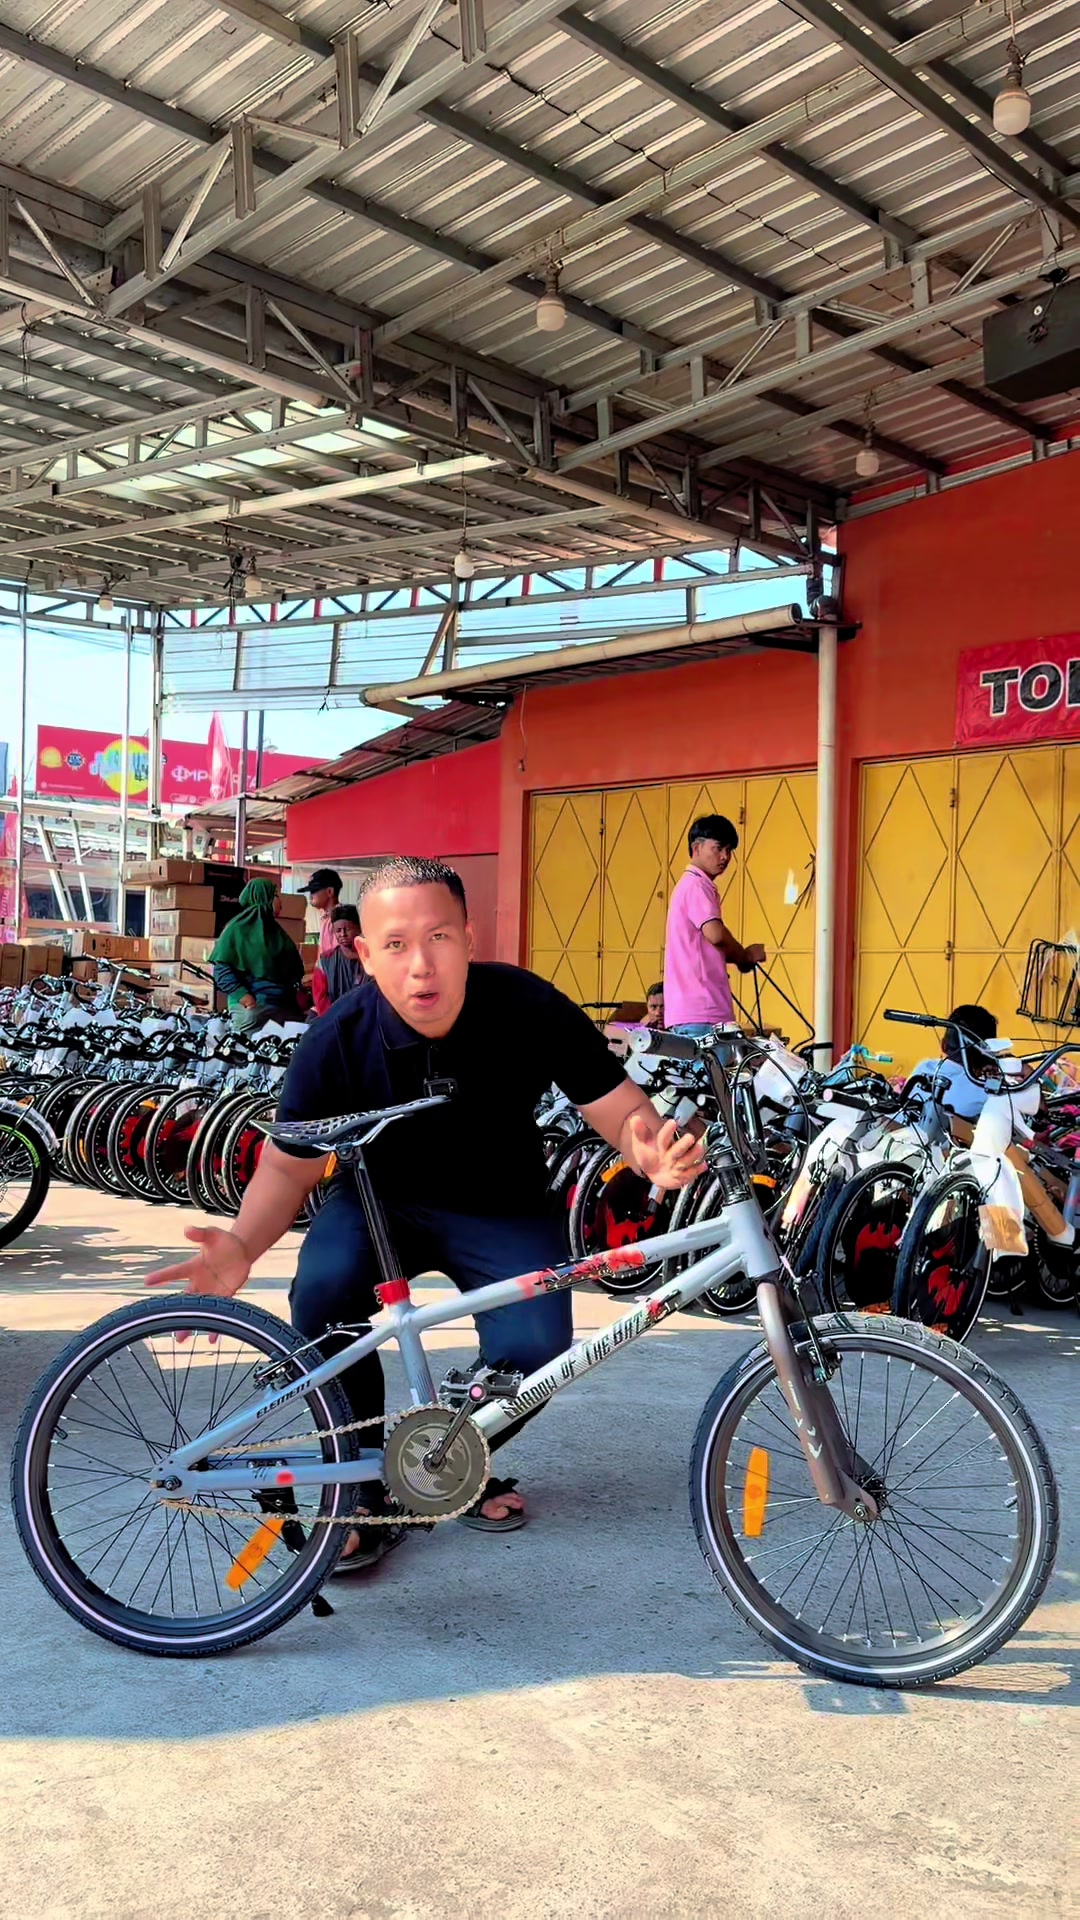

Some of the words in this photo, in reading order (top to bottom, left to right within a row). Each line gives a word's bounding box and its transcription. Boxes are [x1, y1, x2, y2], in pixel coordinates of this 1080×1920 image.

[560, 1352, 577, 1379] OF
[582, 1335, 611, 1366] THE
[612, 1310, 644, 1347] BAT
[256, 1379, 312, 1418] ELEMENT
